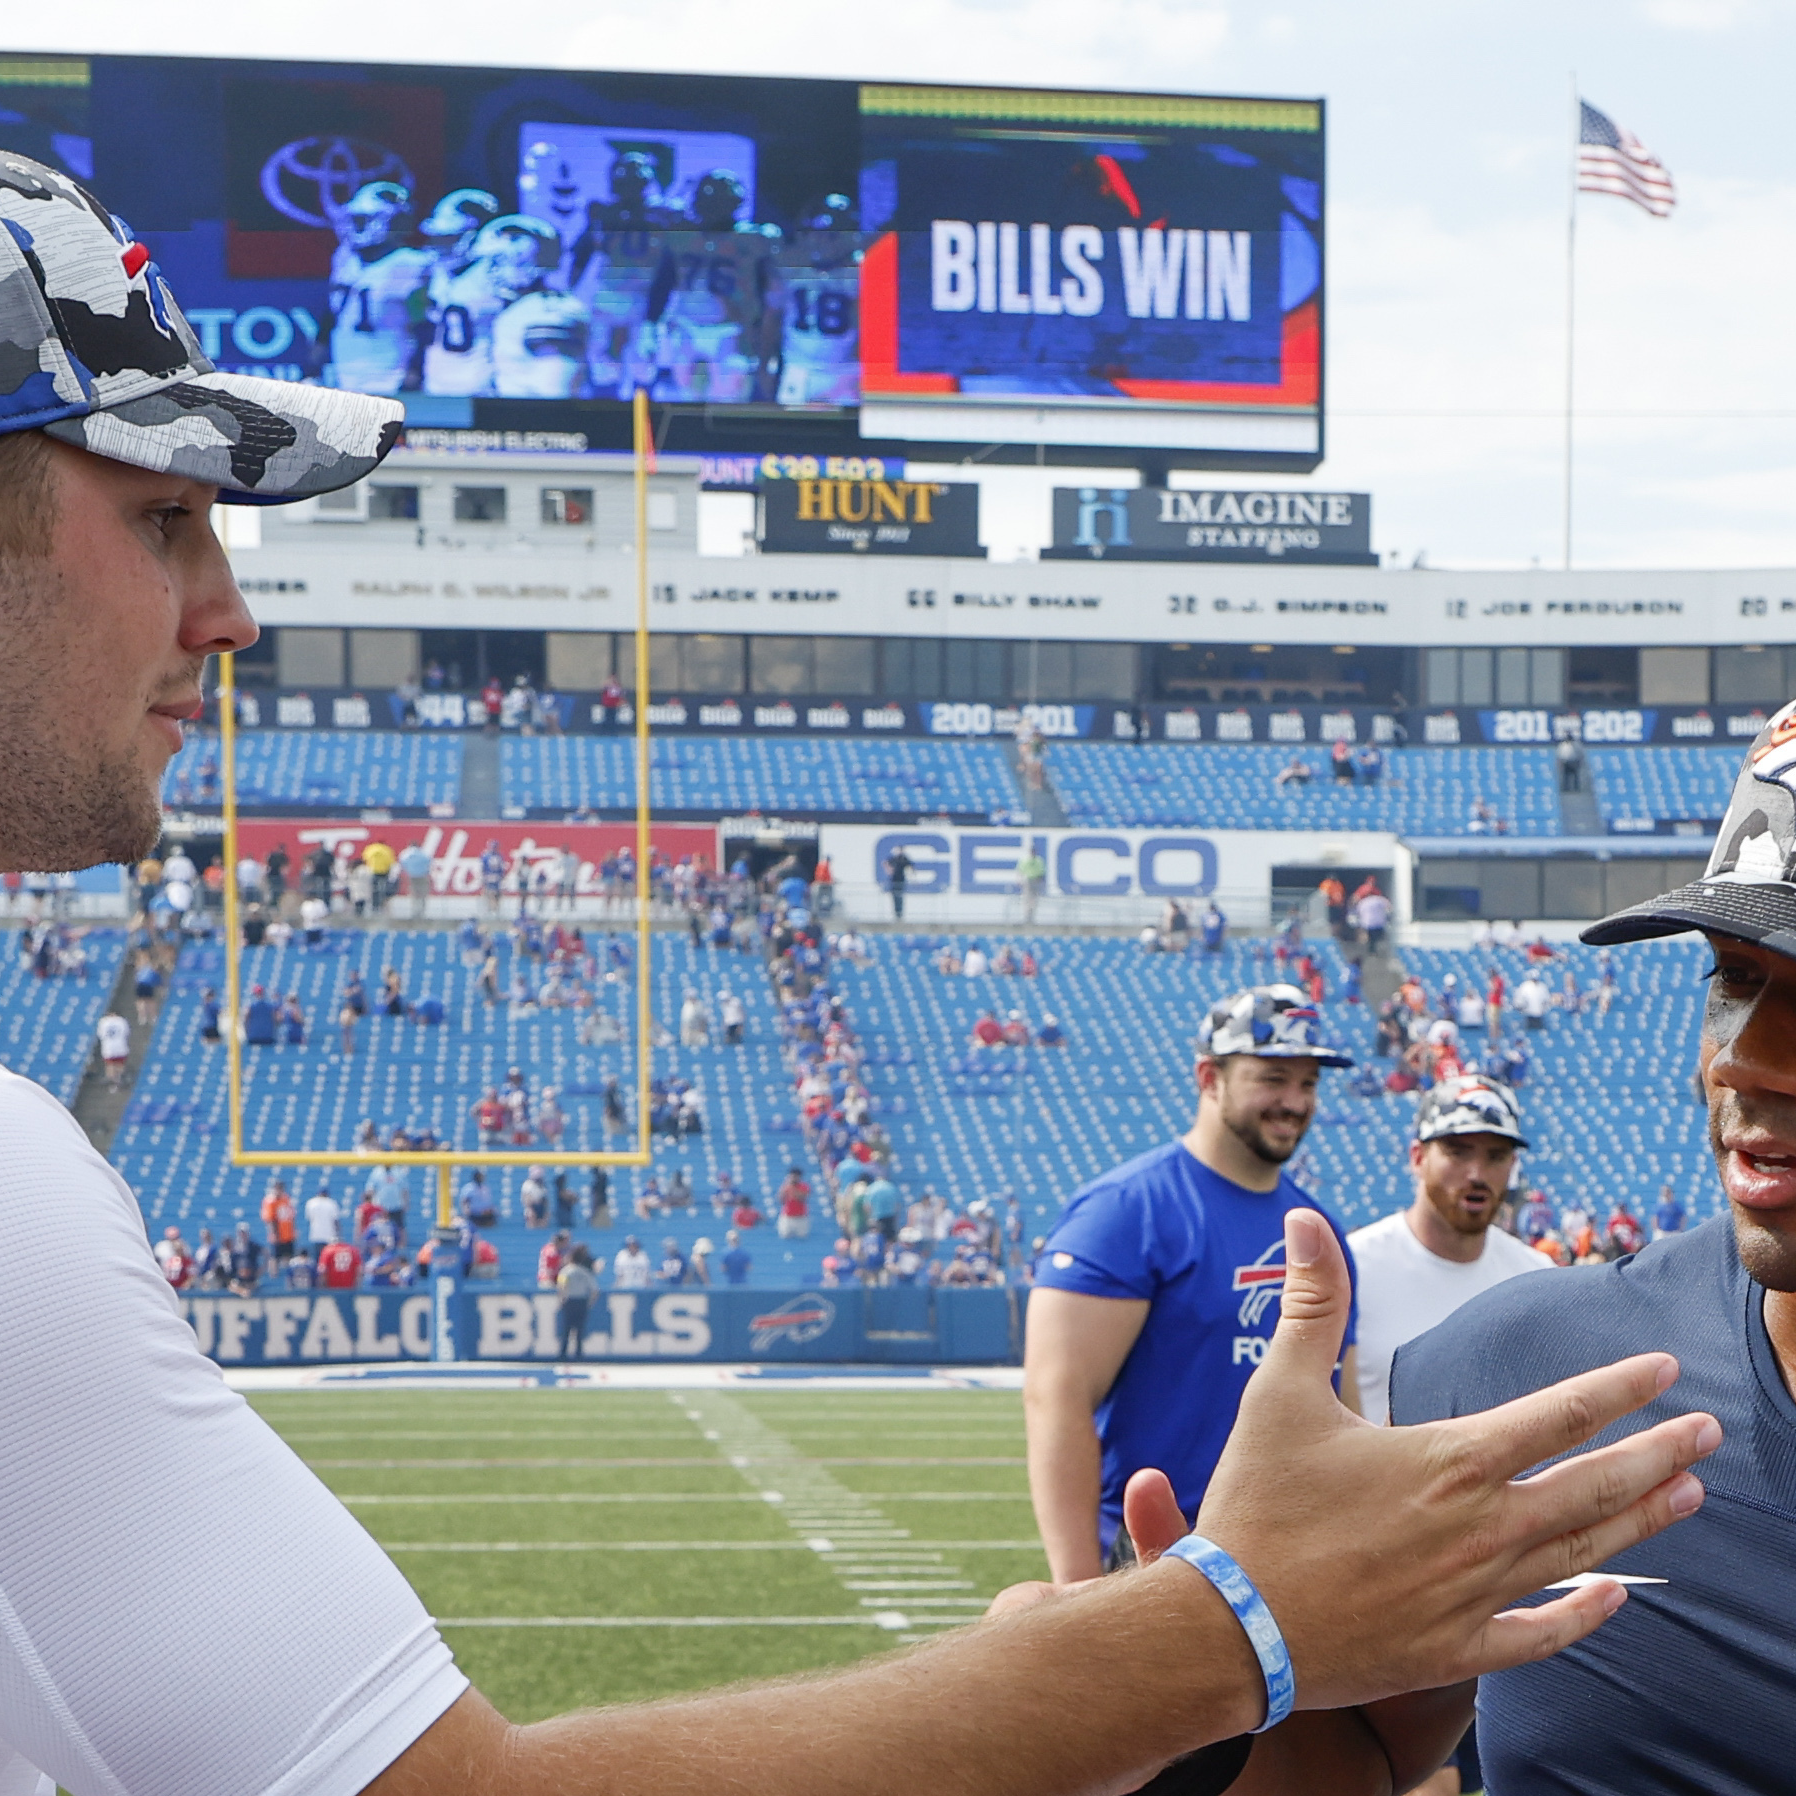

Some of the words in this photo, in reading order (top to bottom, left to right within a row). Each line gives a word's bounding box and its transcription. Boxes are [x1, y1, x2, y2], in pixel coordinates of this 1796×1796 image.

[931, 219, 1103, 317] BILLS
[1117, 226, 1251, 322] WIN
[505, 431, 588, 452] ELECTRIC
[796, 478, 937, 524] HUNT
[1157, 491, 1353, 525] IMAGINE
[1186, 527, 1321, 548] STAFFING
[691, 590, 759, 603] JACK
[769, 590, 840, 603] KEMP
[953, 593, 1014, 607] BILLY
[1028, 595, 1101, 608] SHAW
[1275, 599, 1389, 615] SIMPSON
[1483, 602, 1533, 616] JOE
[1546, 602, 1683, 616] FERGUSON
[931, 702, 993, 735] 200
[1494, 709, 1552, 743] 201
[1583, 709, 1644, 743] 202
[179, 1295, 433, 1361] UFFALO
